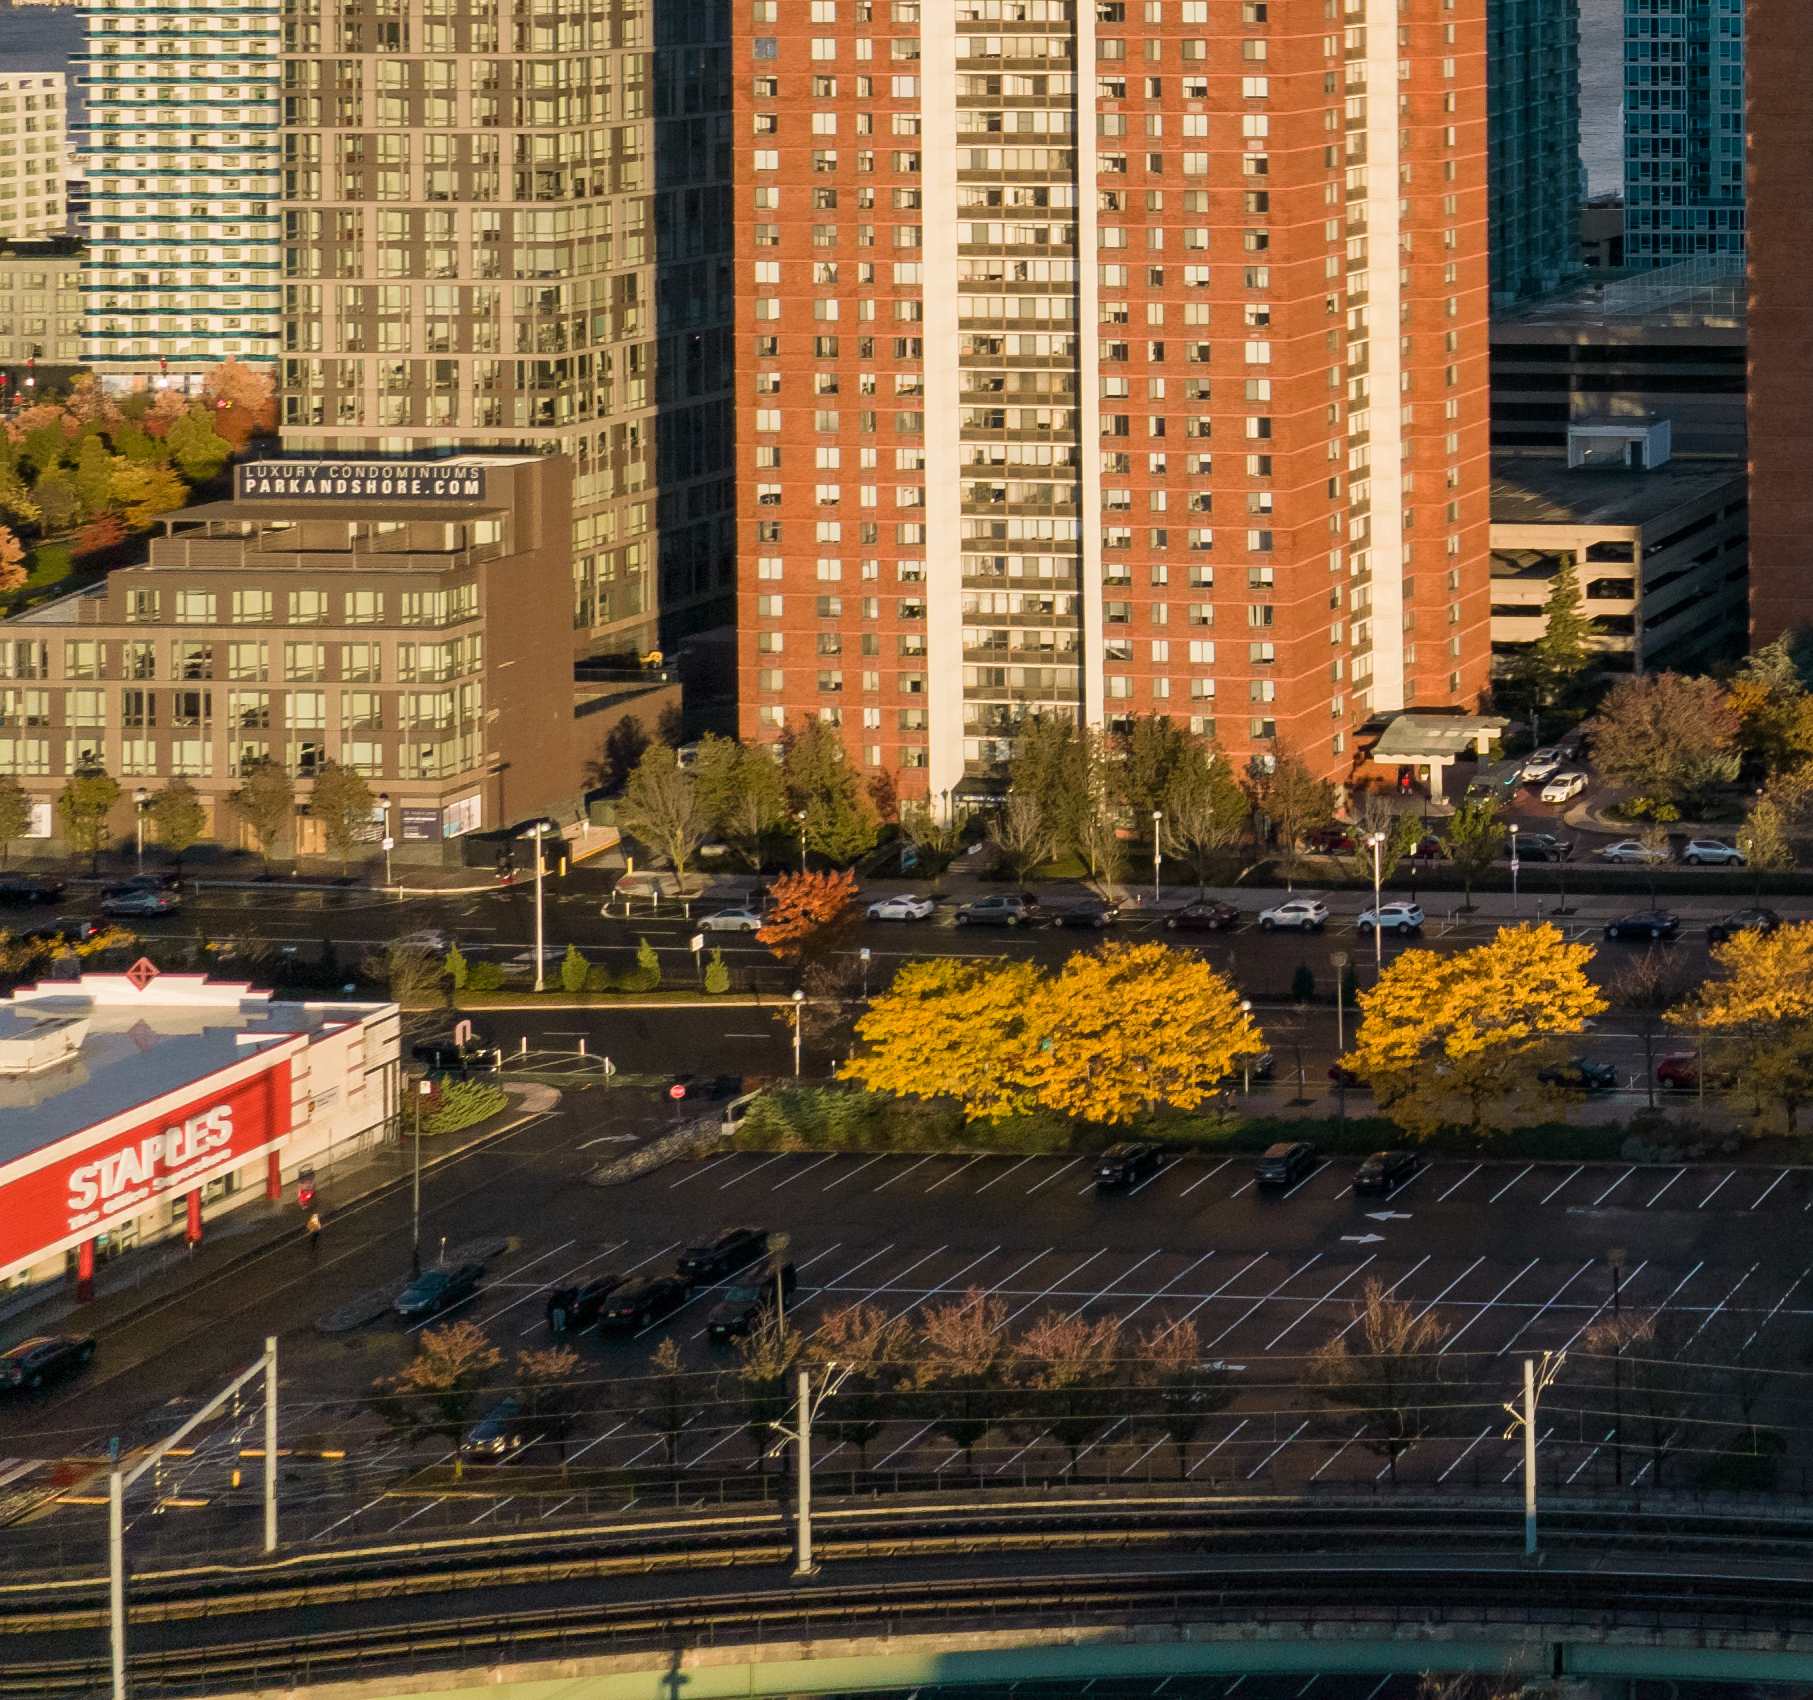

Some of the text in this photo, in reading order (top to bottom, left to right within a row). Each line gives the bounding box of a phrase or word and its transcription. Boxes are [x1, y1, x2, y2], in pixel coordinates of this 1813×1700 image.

[246, 467, 480, 478] LUXURY CONDOMINIUMS
[246, 479, 479, 495] PARKANDSHORE.COM
[68, 1105, 233, 1210] STAPLES
[68, 1211, 99, 1230] The
[103, 1187, 149, 1213] Office
